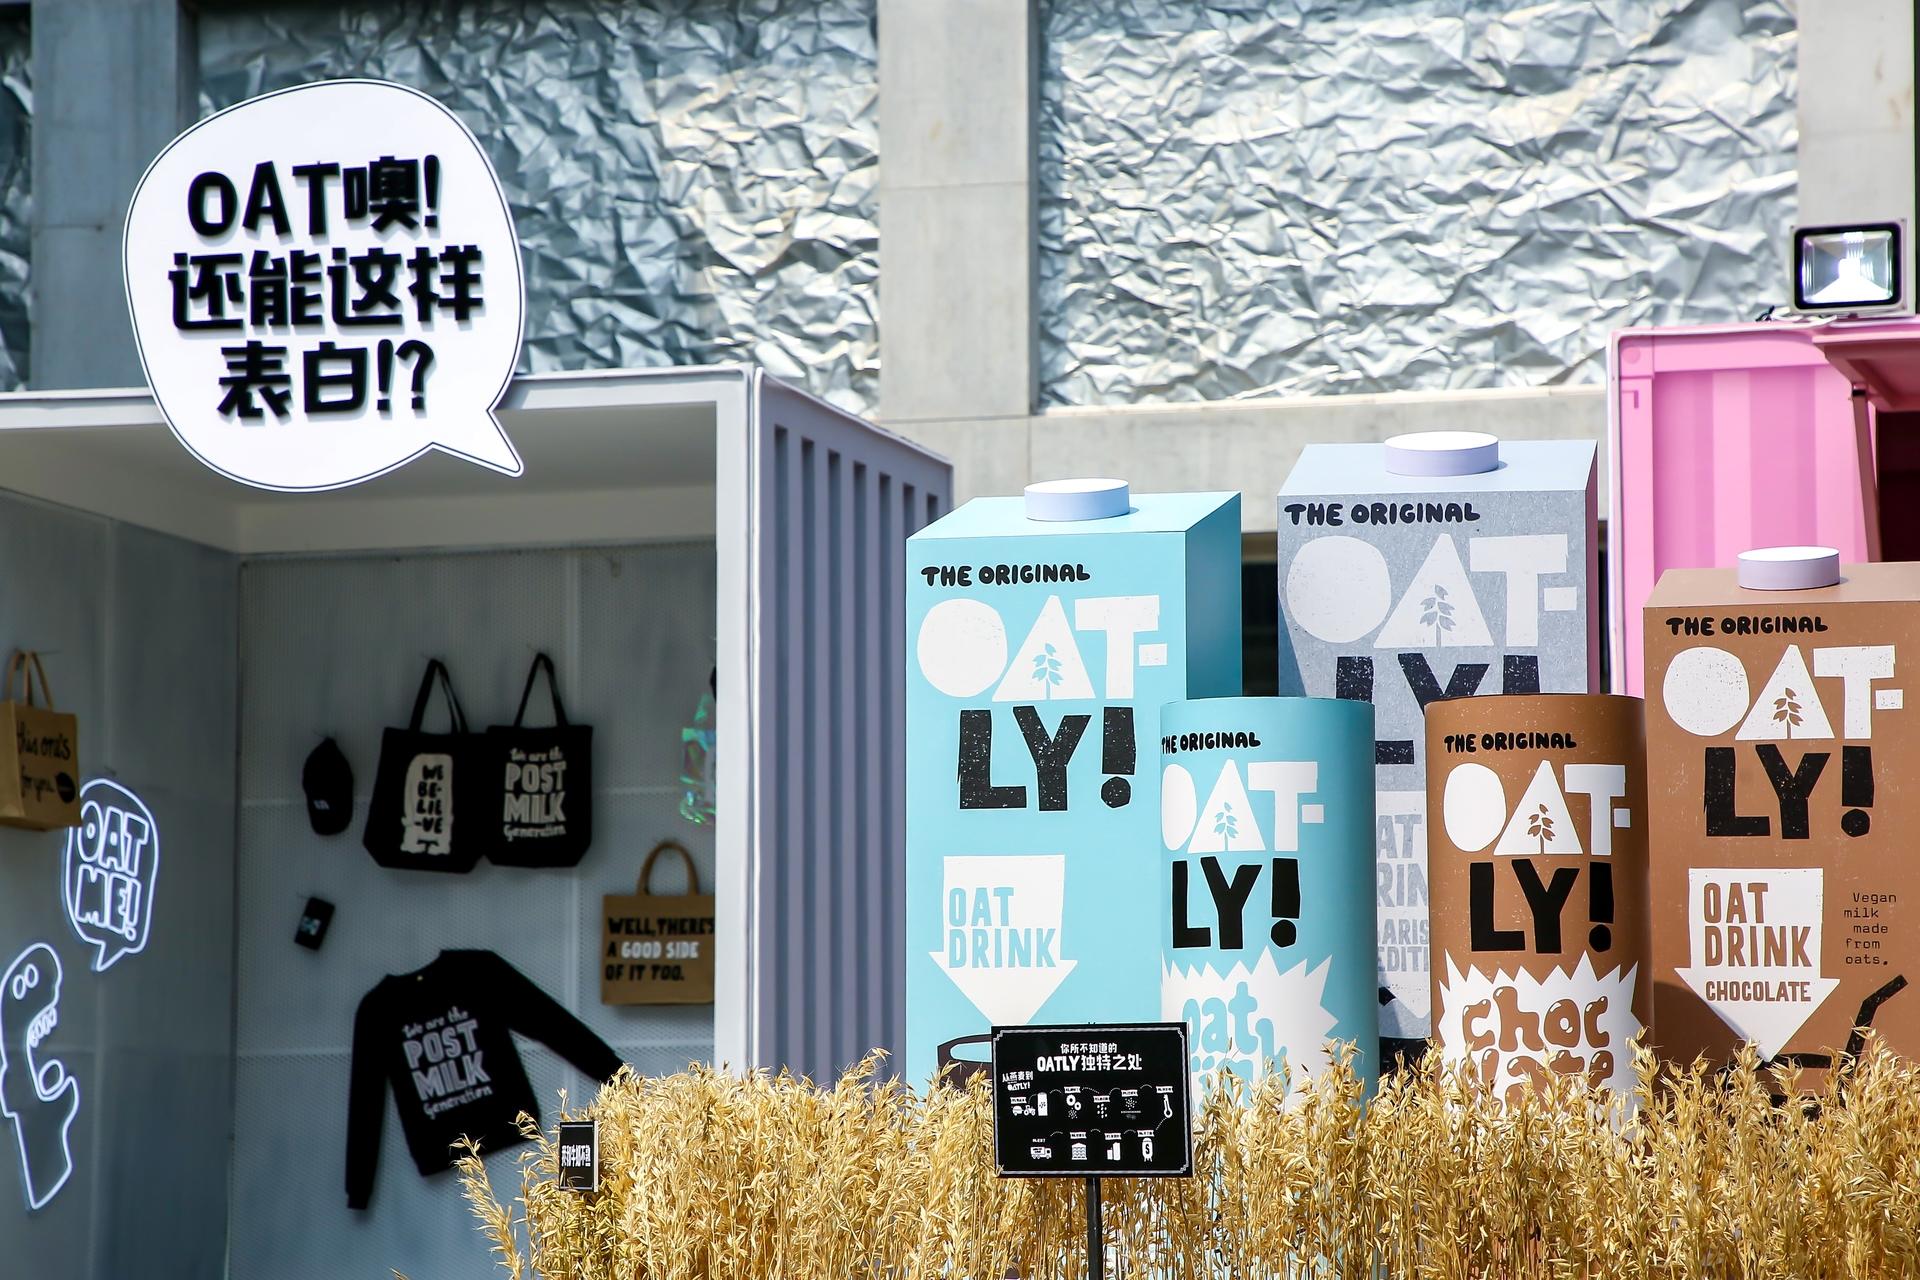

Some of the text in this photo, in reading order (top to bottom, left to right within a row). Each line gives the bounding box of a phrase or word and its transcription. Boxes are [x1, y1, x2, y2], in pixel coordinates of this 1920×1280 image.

[188, 155, 441, 237] OAT噢!
[168, 245, 484, 330] 还能这样
[217, 339, 435, 419] 表白!?
[1284, 502, 1481, 527] THE ORIGINAL
[921, 563, 1091, 587] THE ORIGINAL
[1666, 616, 1829, 636] THE ORIGINAL
[957, 705, 1136, 812] LY!
[1161, 731, 1262, 754] THE ORIGINAL
[1444, 732, 1577, 754] THE ORIGINAL
[422, 764, 444, 781] WE
[505, 761, 567, 793] POST
[416, 799, 443, 816] LIE
[503, 791, 567, 824] MILK
[1704, 744, 1875, 840] LY!
[77, 800, 149, 878] OAT
[1377, 814, 1422, 859] AT
[1378, 863, 1428, 908] RIN
[1853, 892, 1898, 905] Vegan
[75, 863, 142, 941] ME!
[948, 886, 1015, 928] OAT
[1172, 856, 1301, 950] LY!
[1469, 858, 1615, 954] LY!
[1703, 882, 1769, 924] OAT
[1843, 907, 1879, 918] milk
[1378, 919, 1429, 945] ARIS
[1845, 938, 1881, 949] from
[1853, 923, 1889, 934] made
[607, 941, 700, 959] A GOOD SIDE
[948, 927, 1057, 969] DRINK
[1378, 946, 1429, 972] EDITI
[1704, 925, 1813, 968] DRINK
[1845, 954, 1889, 966] oats.
[605, 963, 685, 981] OF IT TOO.
[1705, 981, 1812, 1002] CHOCOLATE
[1462, 986, 1610, 1052] choc
[402, 1018, 479, 1070] POST
[1061, 1043, 1118, 1054] 你所不知道的
[411, 1049, 491, 1101] MILK
[1037, 1054, 1143, 1072] OATLY 独特之处
[423, 1085, 493, 1120] Generation
